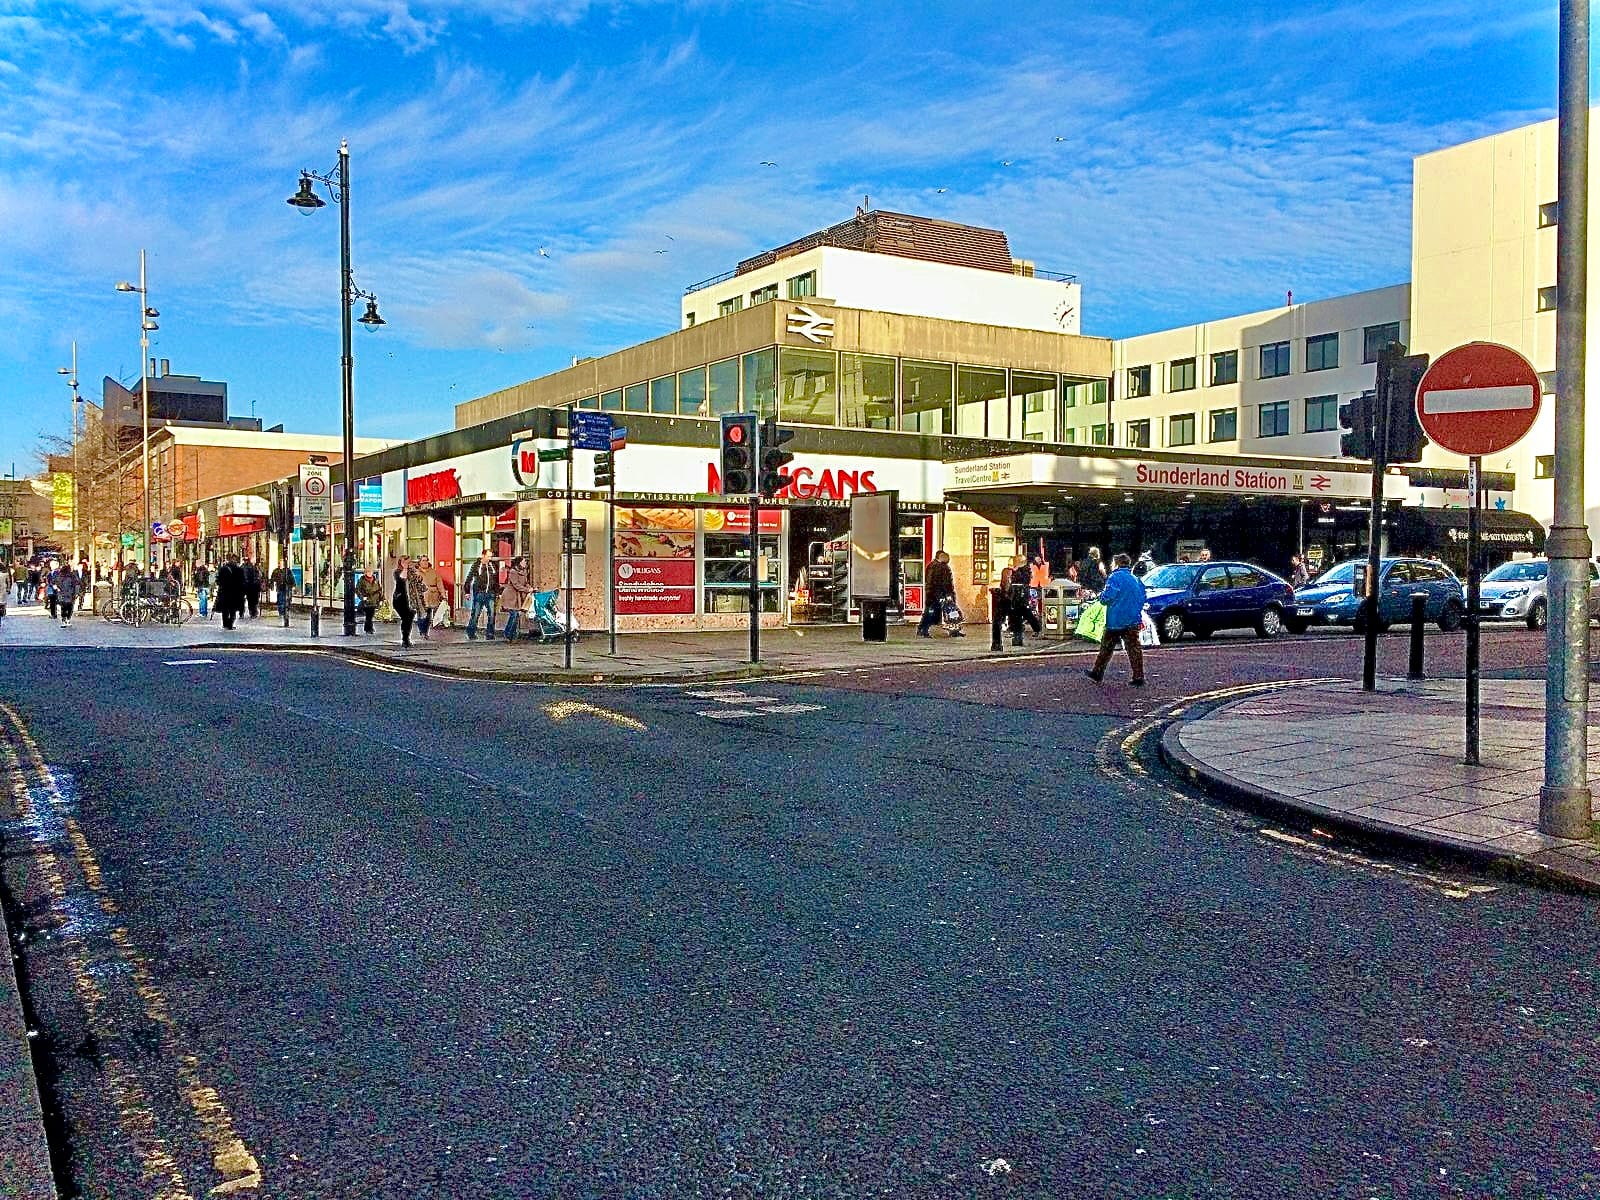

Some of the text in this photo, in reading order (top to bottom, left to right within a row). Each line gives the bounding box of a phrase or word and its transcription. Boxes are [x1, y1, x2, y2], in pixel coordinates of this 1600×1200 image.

[954, 462, 1011, 474] Sunderland Station
[955, 474, 992, 484] TravelCentre
[1136, 463, 1230, 487] Sunderland
[1234, 469, 1287, 490] Station
[633, 492, 696, 502] PATISSERIE
